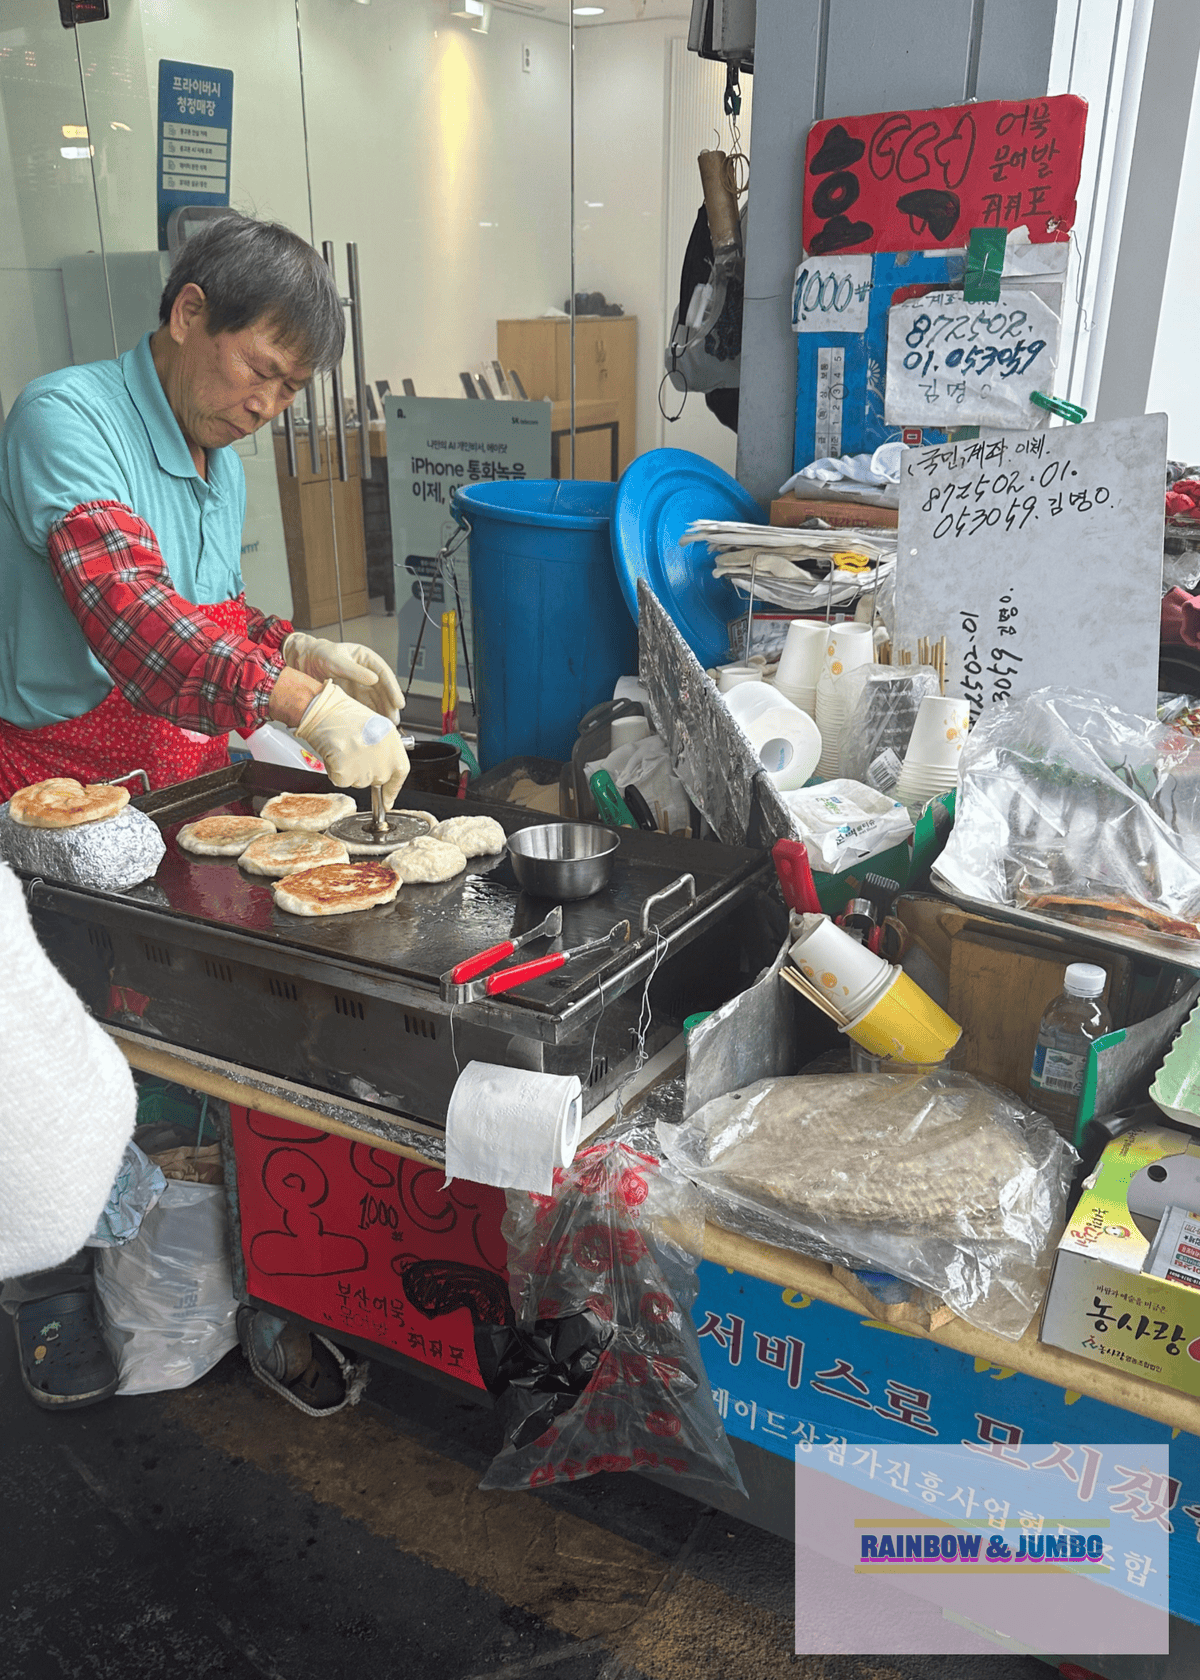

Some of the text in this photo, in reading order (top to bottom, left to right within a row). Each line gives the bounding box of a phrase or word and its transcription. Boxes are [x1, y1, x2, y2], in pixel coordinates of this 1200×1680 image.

[172, 76, 221, 98] 프라이버시
[177, 96, 216, 117] 청정매장
[989, 138, 1060, 182] 문어발
[411, 456, 464, 477] iPhone
[412, 481, 446, 505] 이제,
[336, 1280, 405, 1328] 부산어묵
[1086, 1295, 1186, 1356] 농사랑
[697, 1310, 940, 1437] 서비스로
